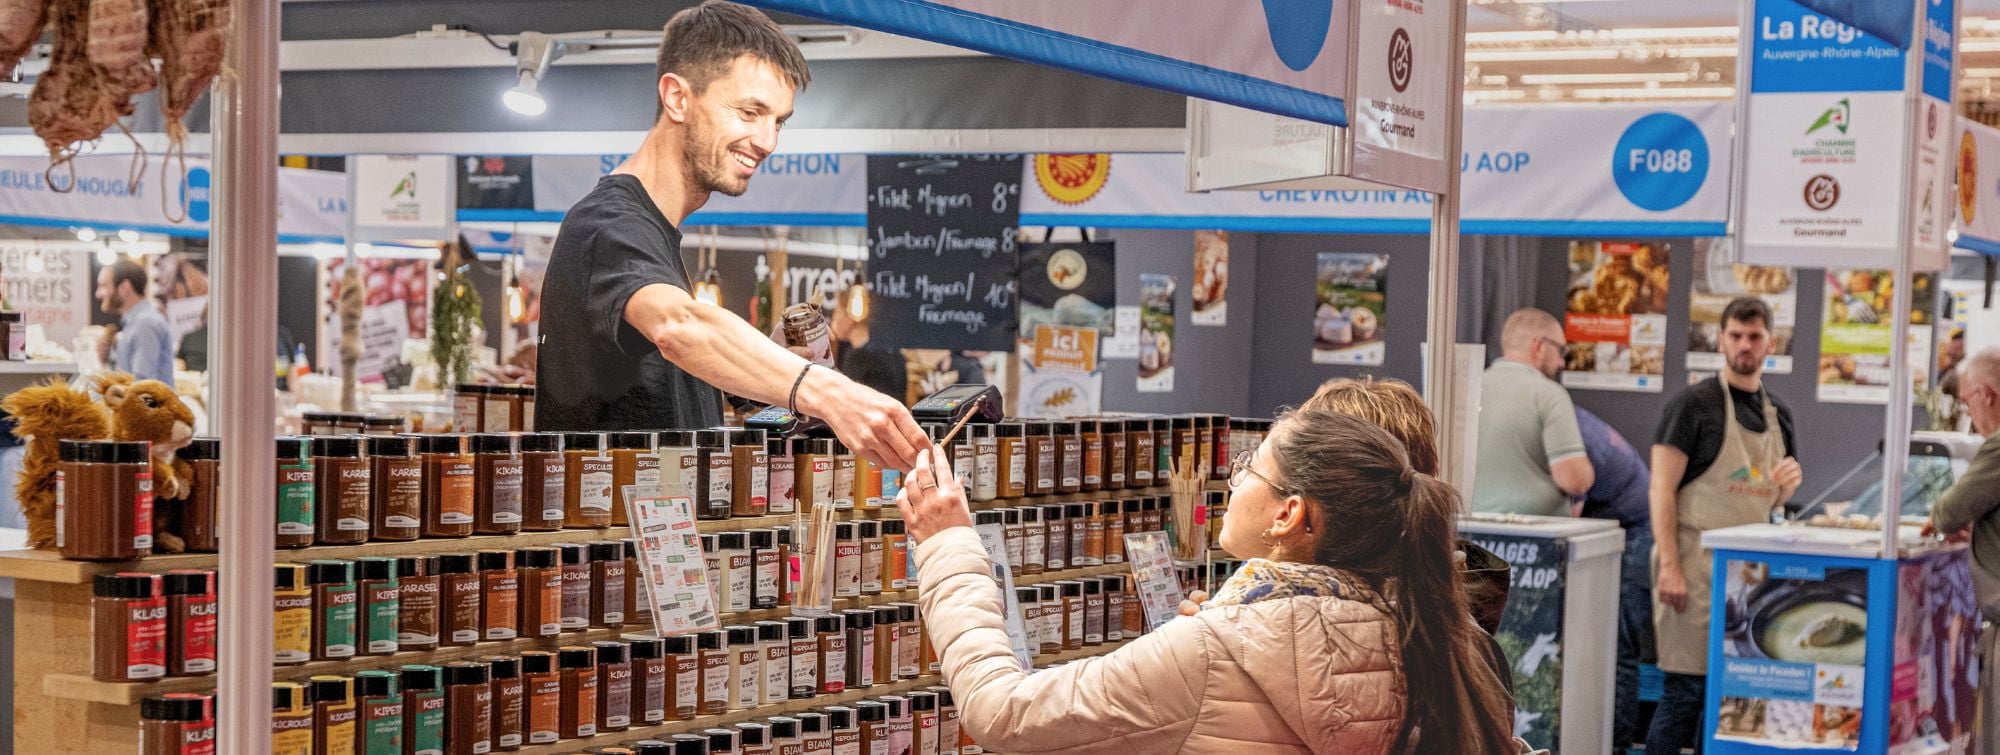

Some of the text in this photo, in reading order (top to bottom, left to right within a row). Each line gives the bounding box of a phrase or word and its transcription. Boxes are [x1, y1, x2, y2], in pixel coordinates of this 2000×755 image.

[1762, 16, 1795, 41] La
[1380, 118, 1416, 138] Gourmand
[1476, 152, 1531, 173] AOP
[1629, 148, 1694, 173] F088
[77, 178, 144, 198] NOUGAT
[1259, 190, 1396, 204] CHEVROTIN
[917, 183, 973, 217] Mignon
[1793, 226, 1848, 238] Gourmand
[918, 303, 987, 333] Fromage
[1051, 330, 1079, 349] ici
[1519, 566, 1559, 590] AOP
